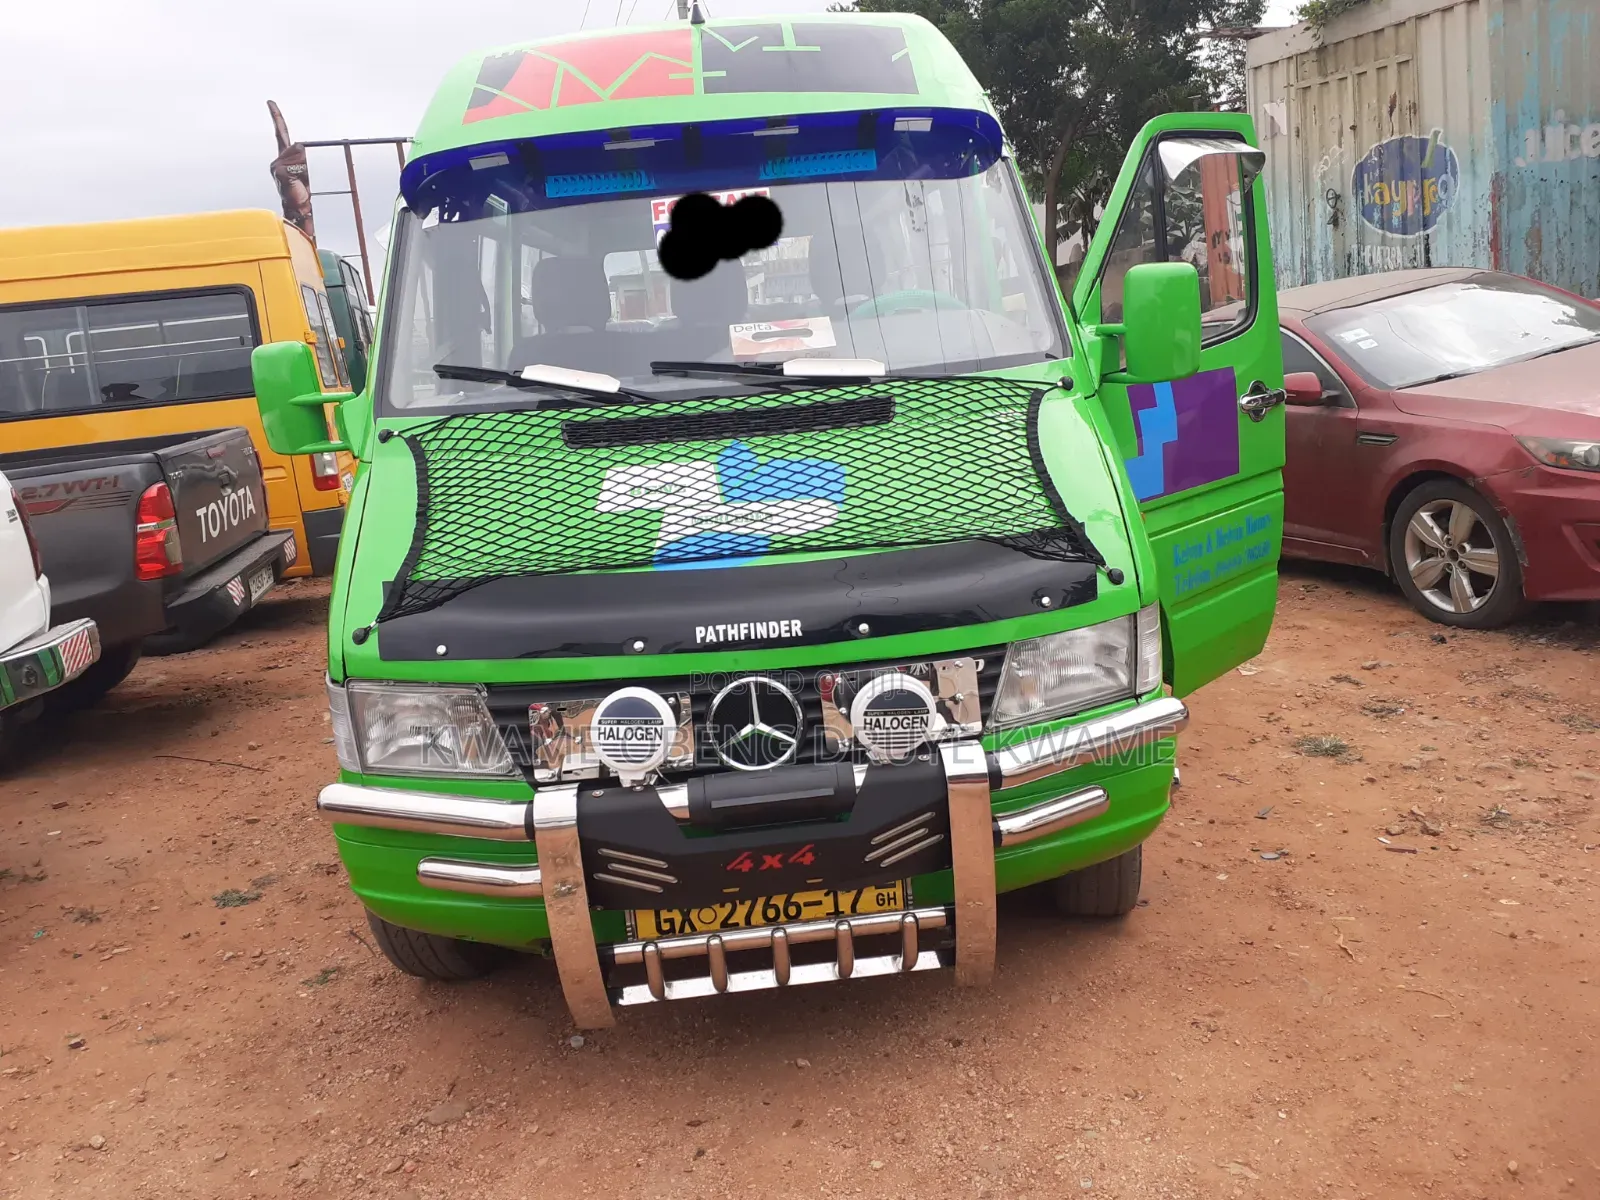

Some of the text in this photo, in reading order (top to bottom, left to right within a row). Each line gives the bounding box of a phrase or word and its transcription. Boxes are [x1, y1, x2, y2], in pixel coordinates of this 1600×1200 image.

[733, 323, 772, 333] Delta
[195, 485, 256, 543] TOYOTA
[695, 619, 803, 644] PATHFINDER
[863, 716, 929, 730] HALOGEN
[598, 726, 663, 741] HALOGEN
[876, 891, 897, 907] GH
